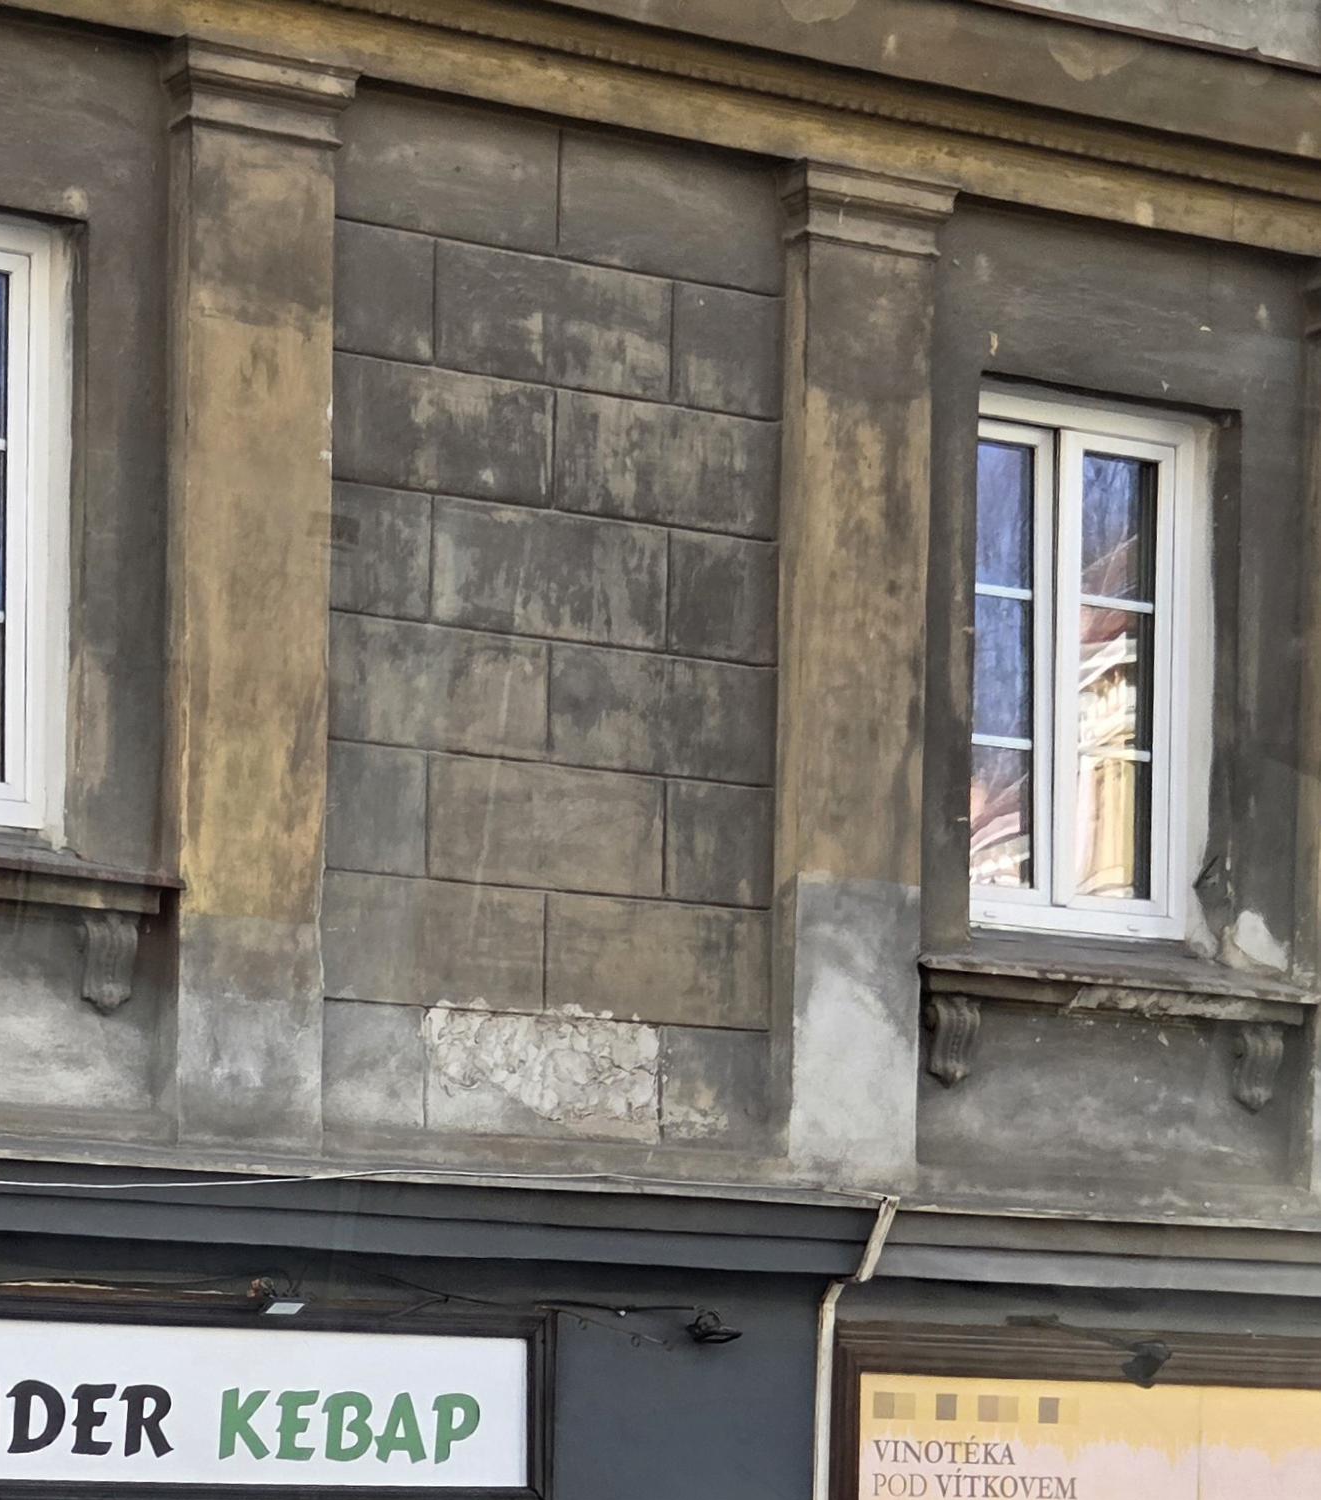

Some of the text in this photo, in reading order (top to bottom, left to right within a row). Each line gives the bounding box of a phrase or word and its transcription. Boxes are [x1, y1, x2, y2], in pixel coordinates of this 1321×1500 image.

[219, 1388, 480, 1464] KEBAP
[873, 1436, 1015, 1465] VINOTÉKA
[873, 1468, 1078, 1500] POD VÍTKOVEM
